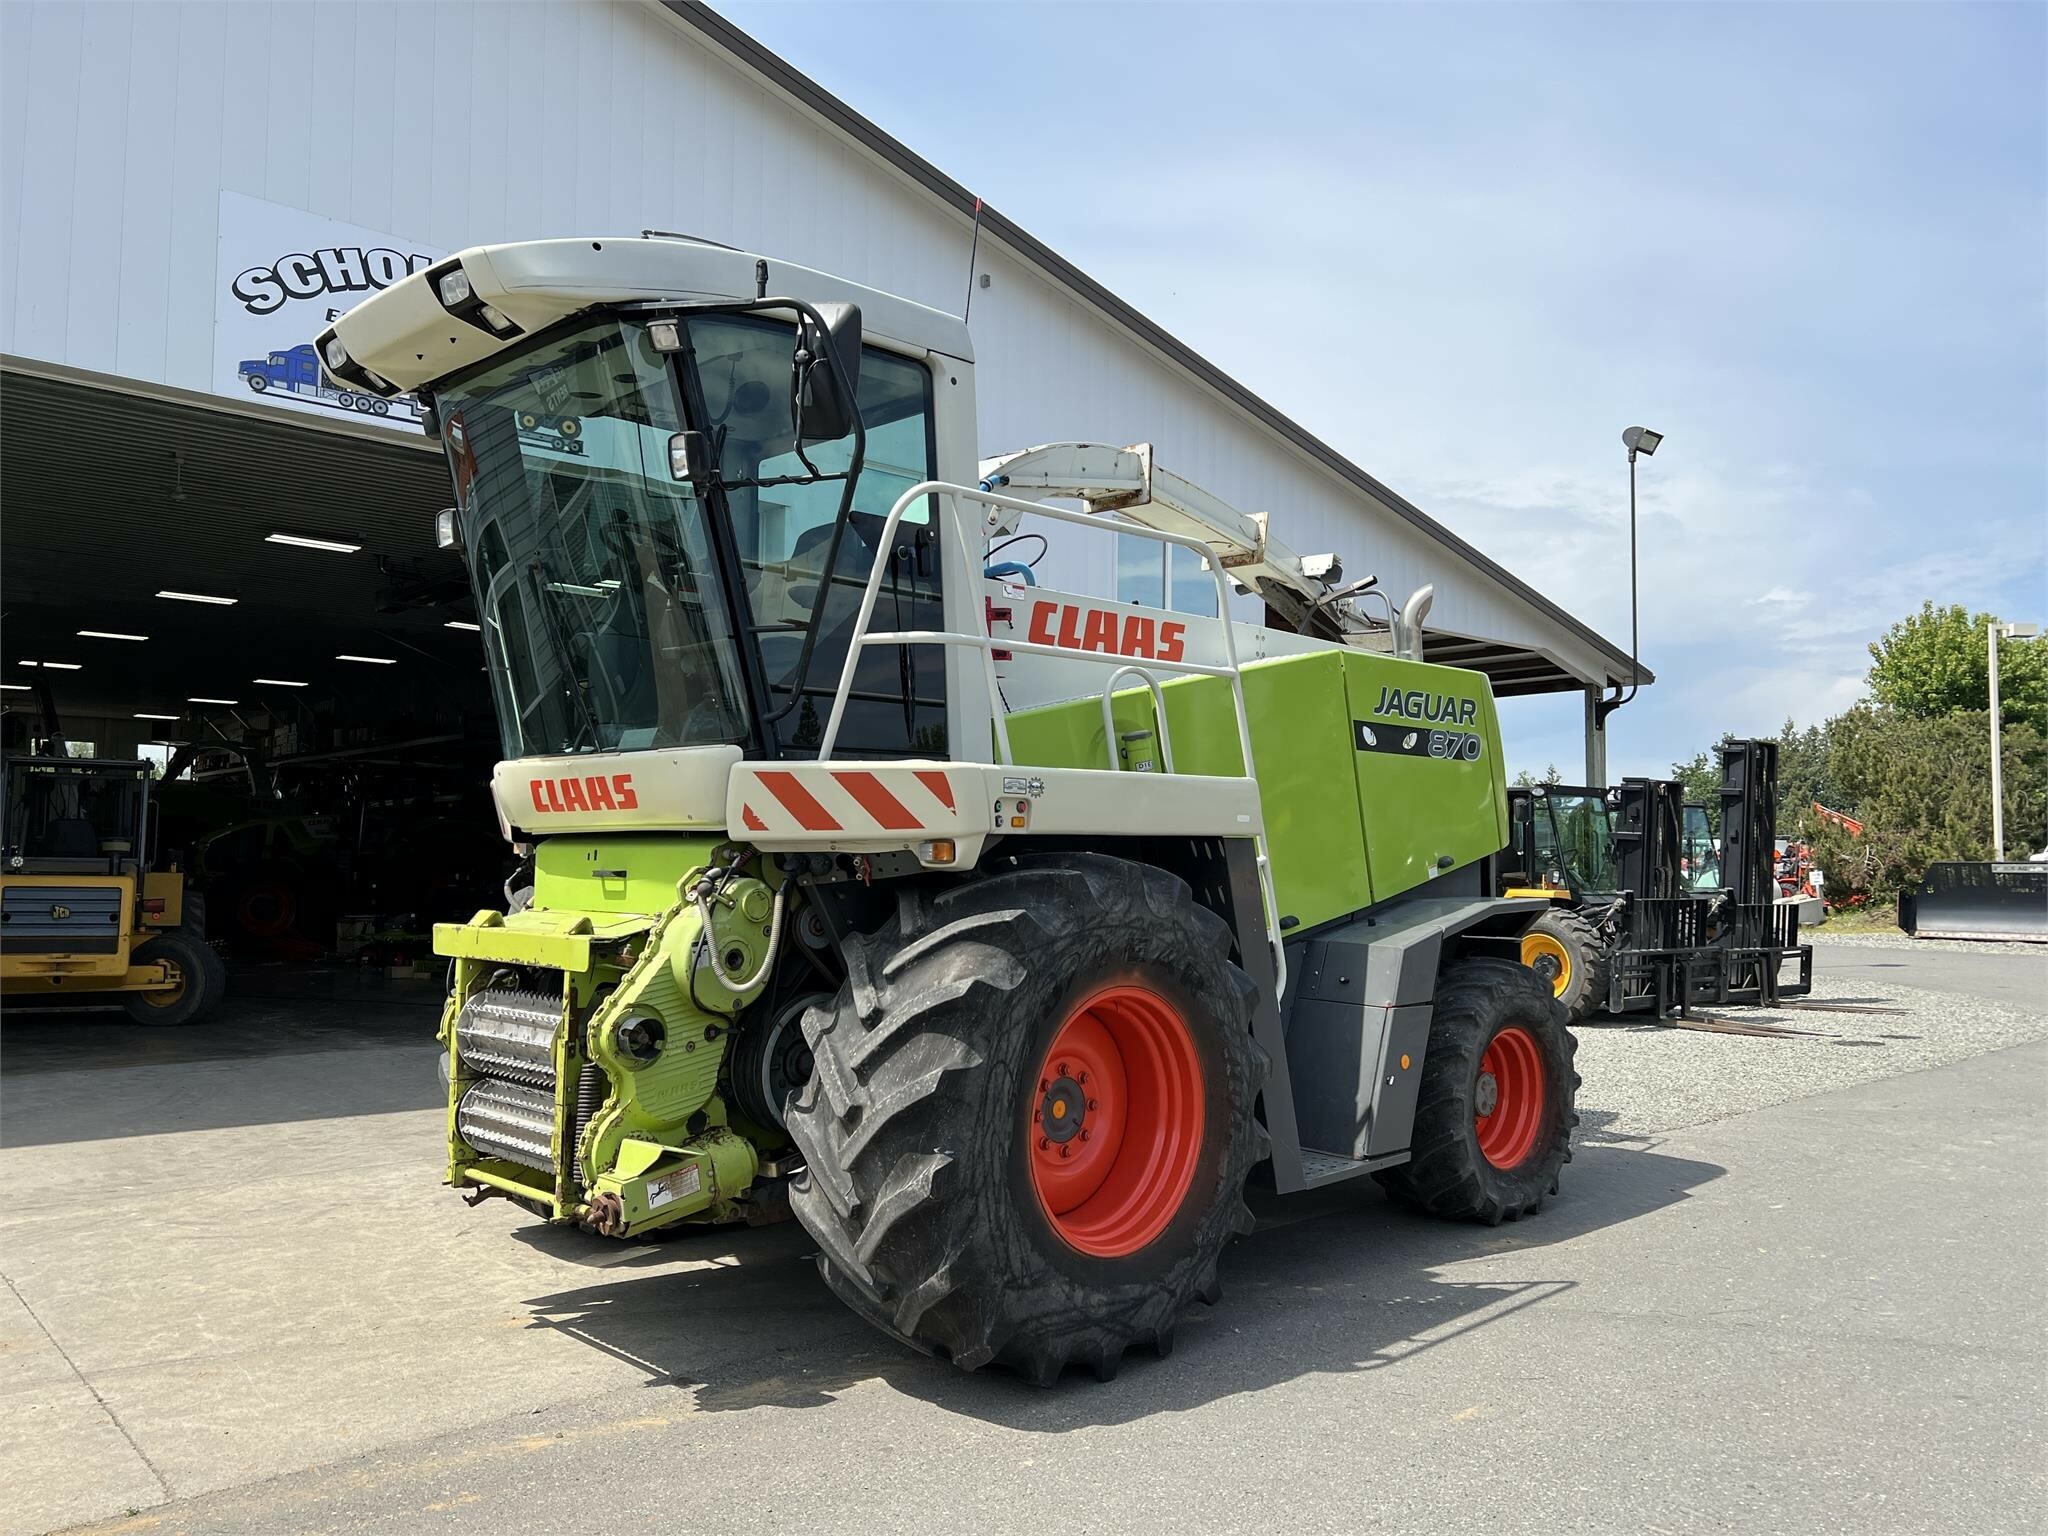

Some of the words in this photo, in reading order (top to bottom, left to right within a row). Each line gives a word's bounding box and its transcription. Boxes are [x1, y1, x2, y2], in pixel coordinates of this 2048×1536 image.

[326, 308, 346, 322] E
[1028, 601, 1185, 663] CLAAS
[1374, 686, 1477, 727] JAGUAR
[1428, 729, 1482, 761] 870
[530, 774, 638, 812] CLAAS
[53, 906, 70, 918] JCB
